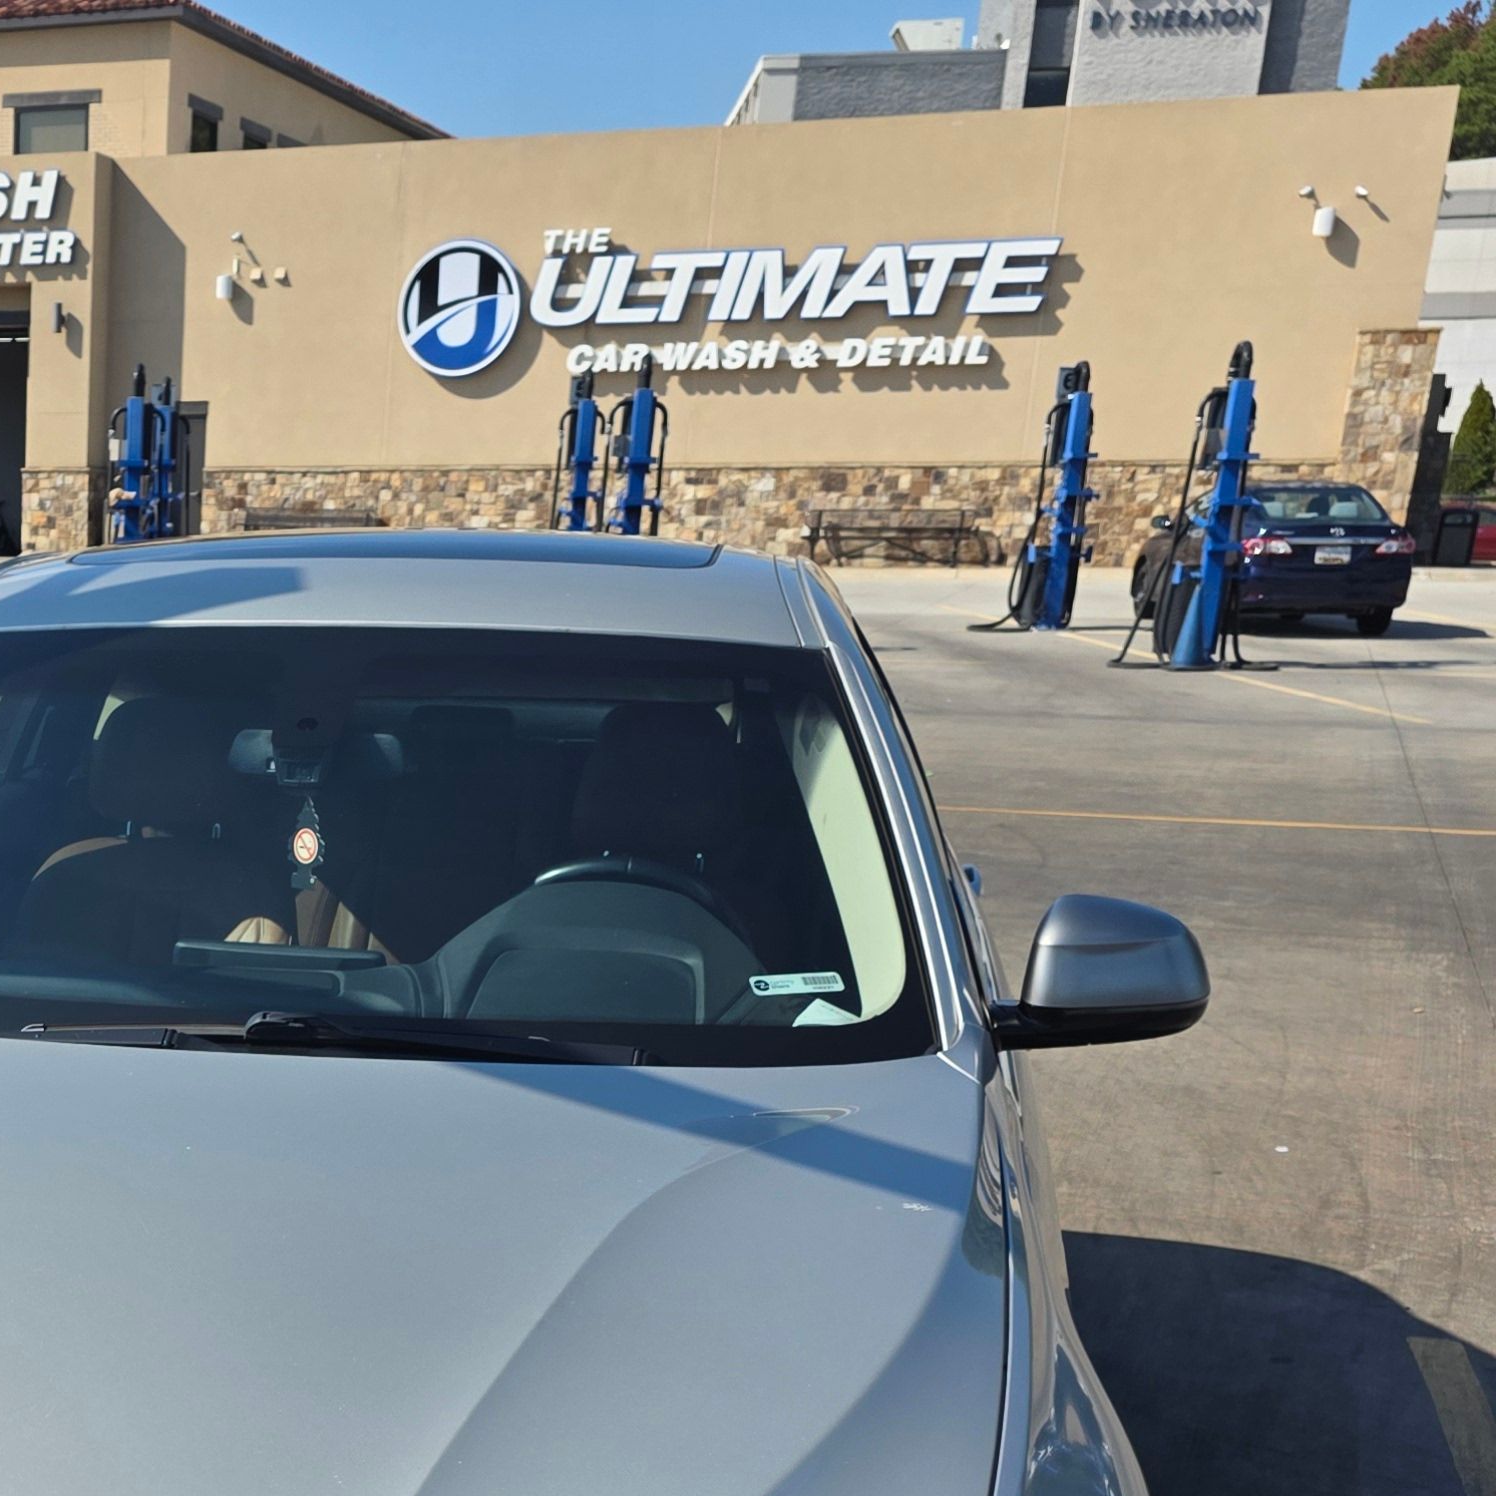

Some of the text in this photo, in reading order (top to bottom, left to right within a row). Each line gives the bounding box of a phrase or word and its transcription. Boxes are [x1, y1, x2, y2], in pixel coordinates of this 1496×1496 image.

[1129, 8, 1258, 30] SHERATON
[544, 228, 612, 253] THE
[529, 236, 1064, 327] ULTIMATE
[567, 335, 990, 374] CAR WASH & DETAIL
